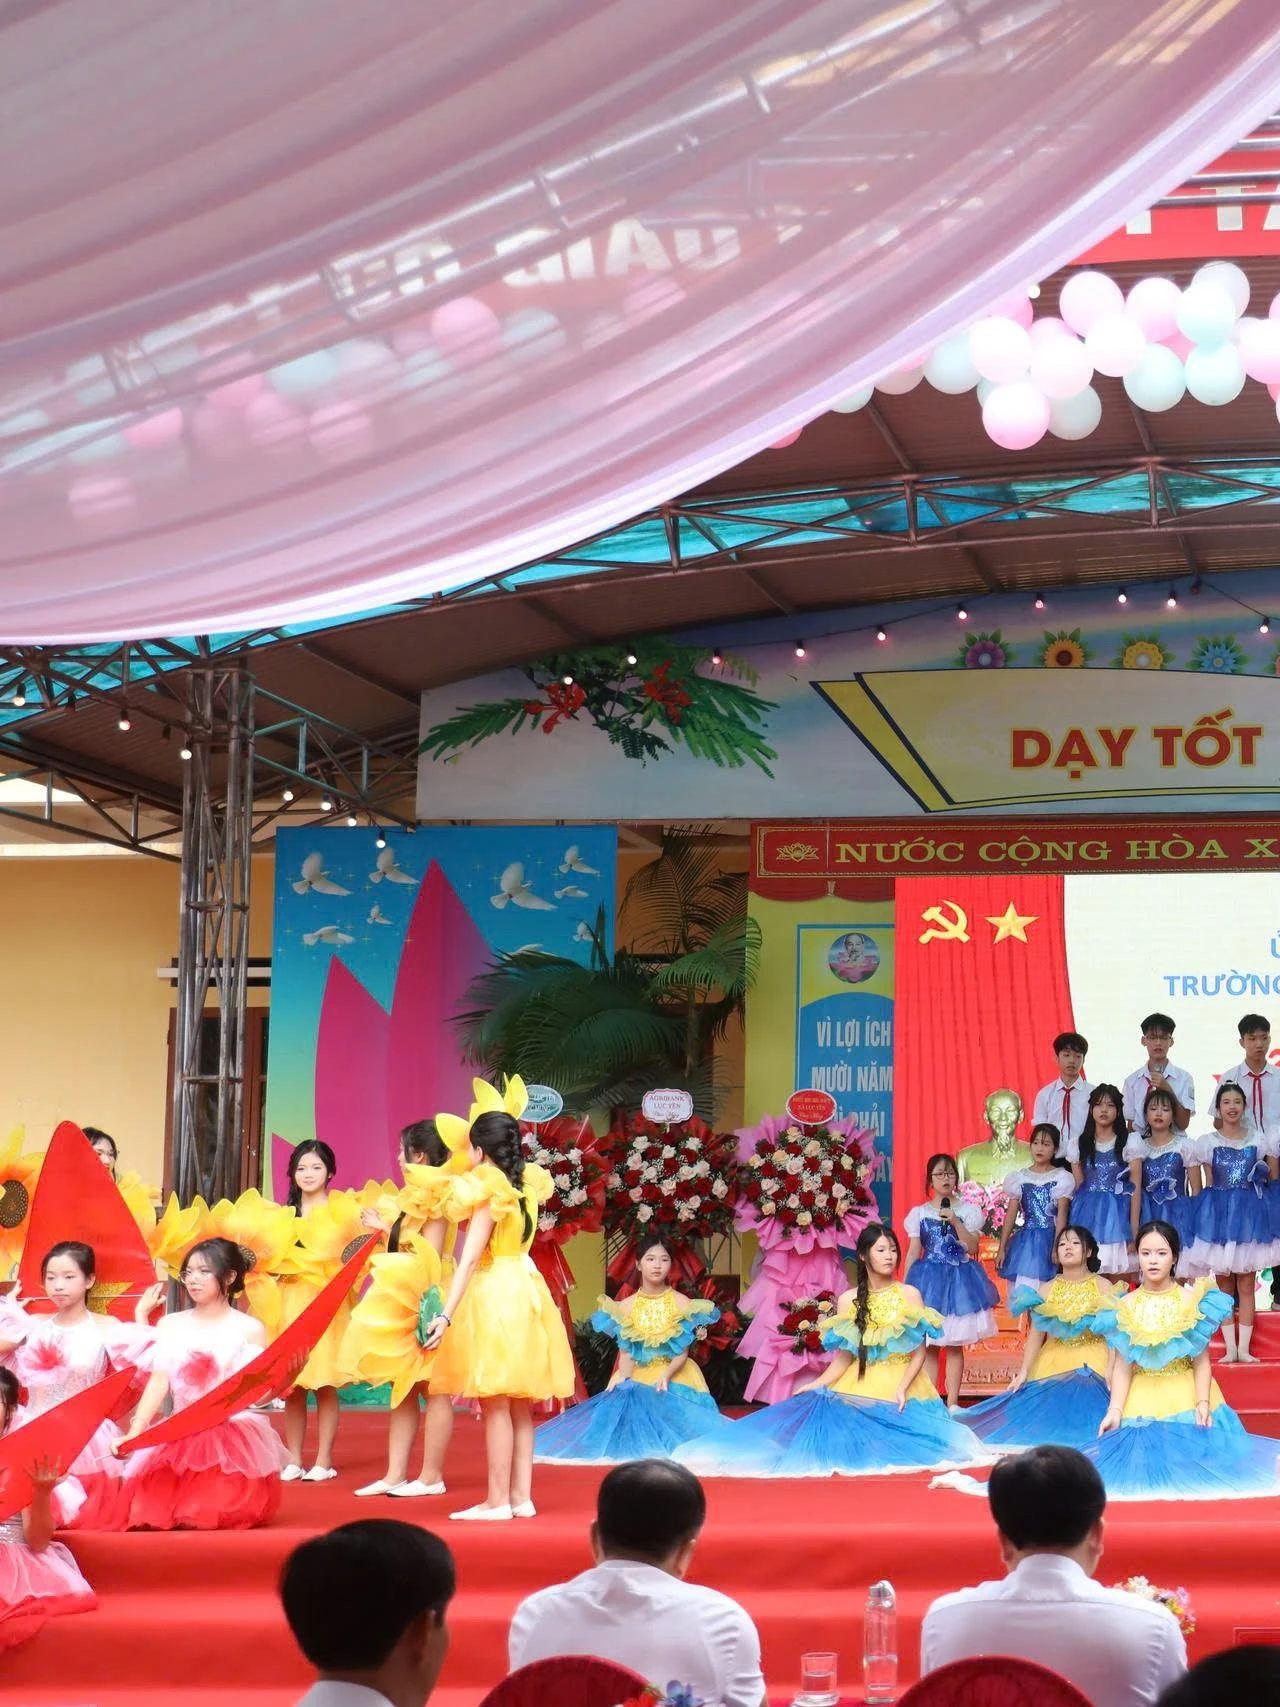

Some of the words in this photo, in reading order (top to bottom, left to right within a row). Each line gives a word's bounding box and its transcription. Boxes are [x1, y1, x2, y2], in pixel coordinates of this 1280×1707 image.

[1012, 727, 1136, 778] DẠY
[1153, 707, 1263, 767] TỐT
[835, 836, 965, 864] NƯỚC
[978, 834, 1112, 867] CỘNG
[1126, 832, 1230, 861] HÒA
[816, 1016, 831, 1048] VÌ
[836, 1018, 860, 1053] LỢI
[865, 1015, 891, 1047] ÍCH
[811, 1061, 851, 1093] MƯỜI
[856, 1061, 893, 1092] NĂM
